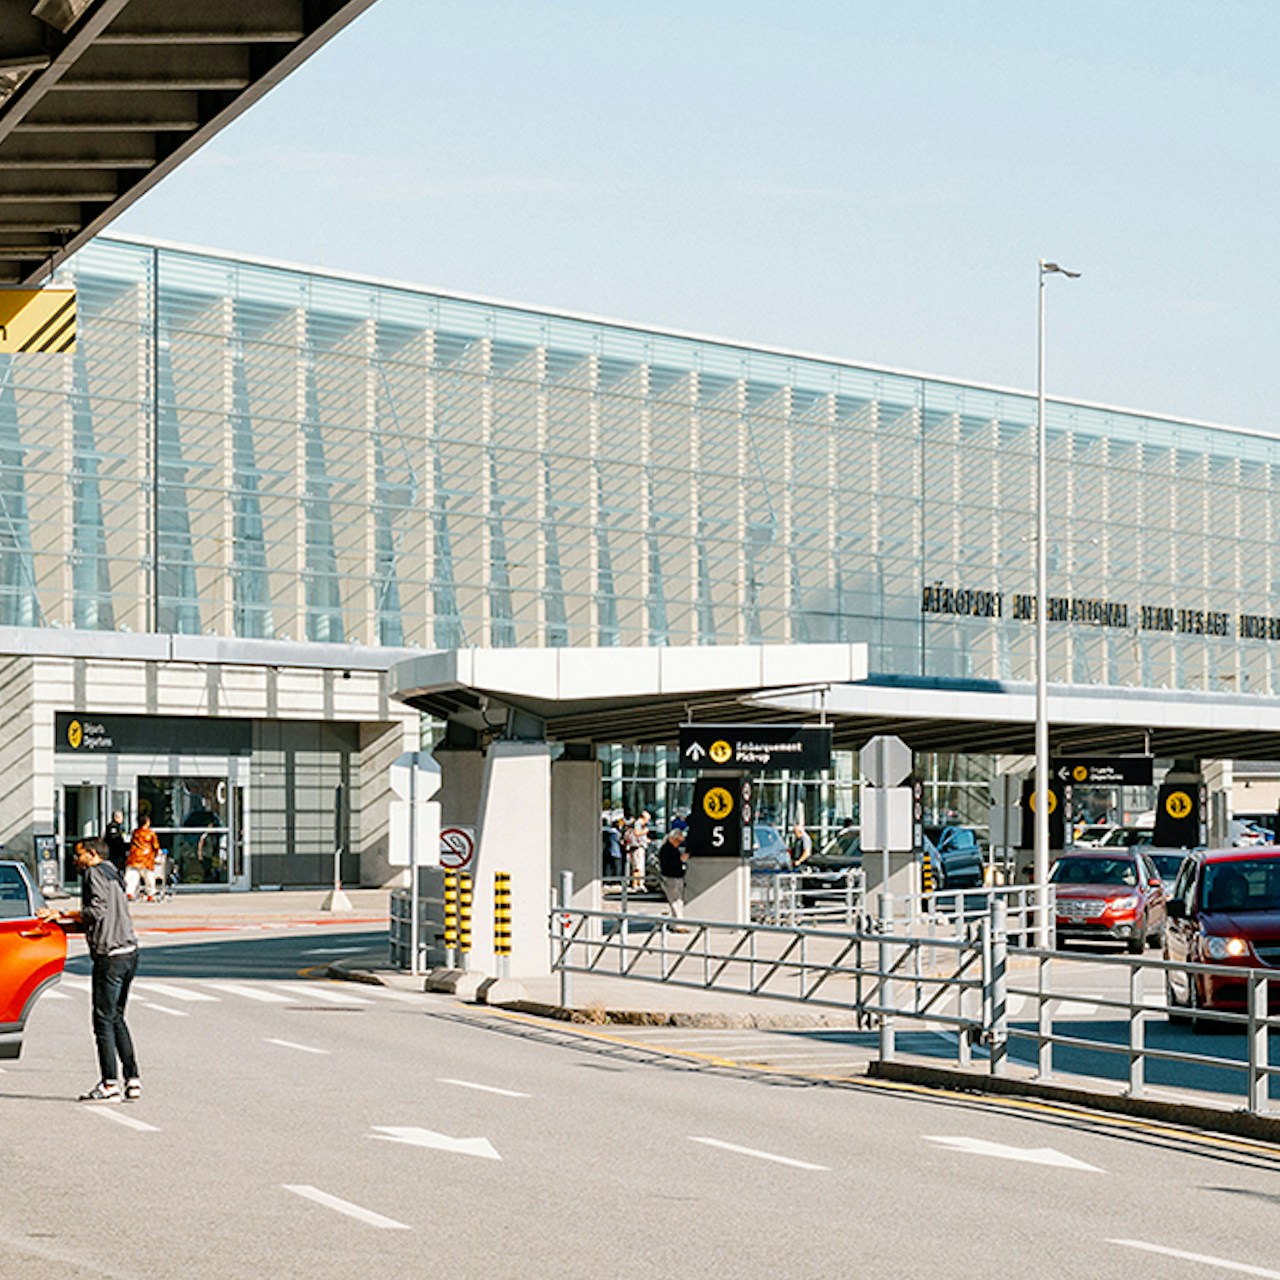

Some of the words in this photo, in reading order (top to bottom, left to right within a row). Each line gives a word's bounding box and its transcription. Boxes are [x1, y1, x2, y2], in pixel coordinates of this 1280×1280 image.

[921, 581, 1006, 618] AÉROPORT
[1013, 594, 1128, 629] INTRNATIONAL
[735, 741, 803, 753] Embarquement
[735, 751, 771, 764] Pick-up
[711, 825, 725, 847] 5
